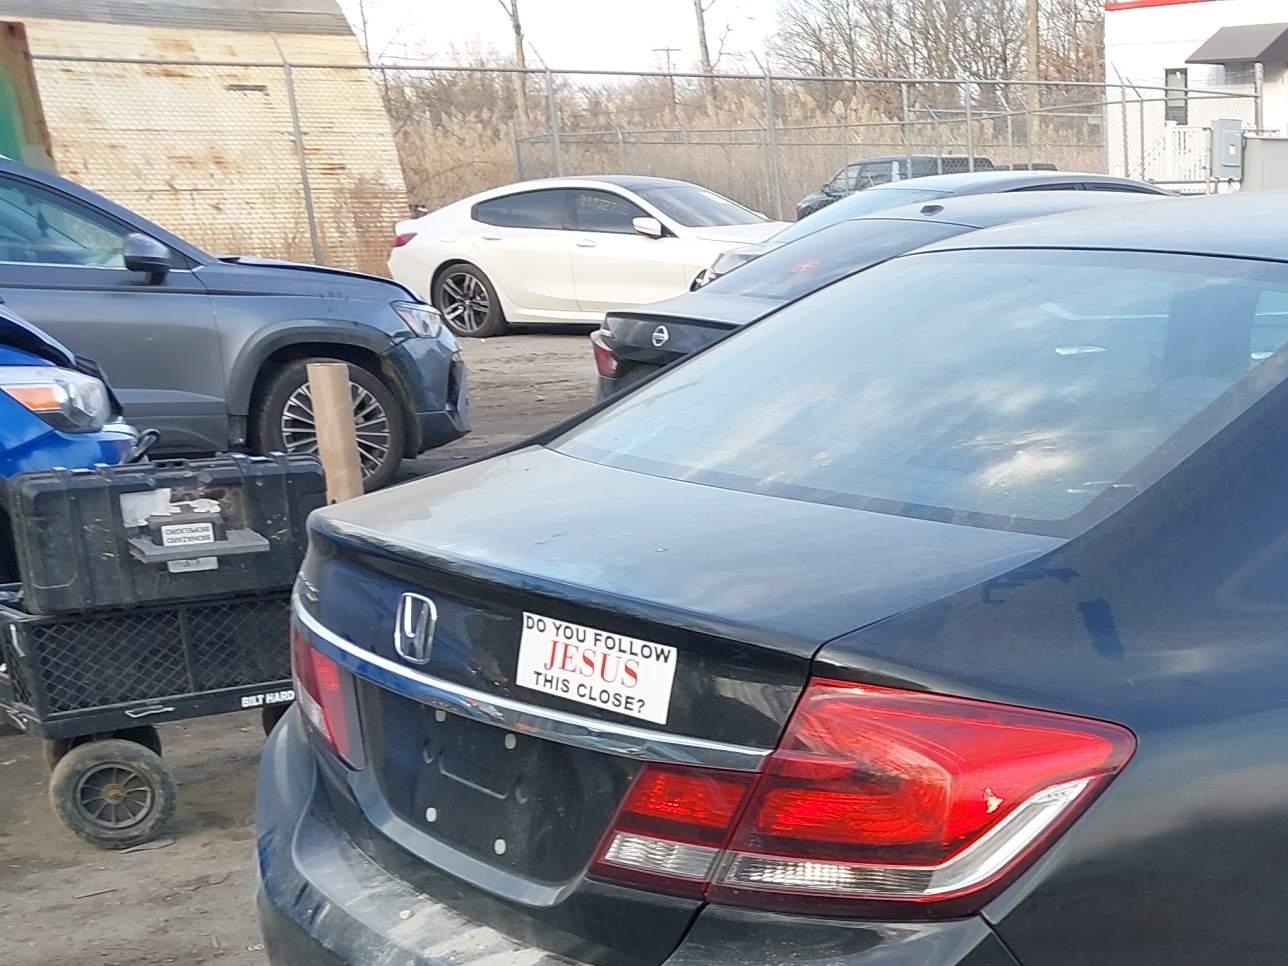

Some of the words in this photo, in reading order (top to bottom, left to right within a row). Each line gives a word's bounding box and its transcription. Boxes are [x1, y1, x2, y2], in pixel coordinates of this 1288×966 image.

[167, 534, 211, 543] BIOHAZARD
[525, 615, 547, 633] DO
[552, 621, 587, 643] YOU
[593, 632, 671, 664] FOLLOW
[544, 639, 640, 689] JESUS
[241, 694, 265, 708] BILT
[265, 690, 296, 704] HARD
[533, 670, 570, 694] THIS
[576, 683, 646, 714] CLOSE?
